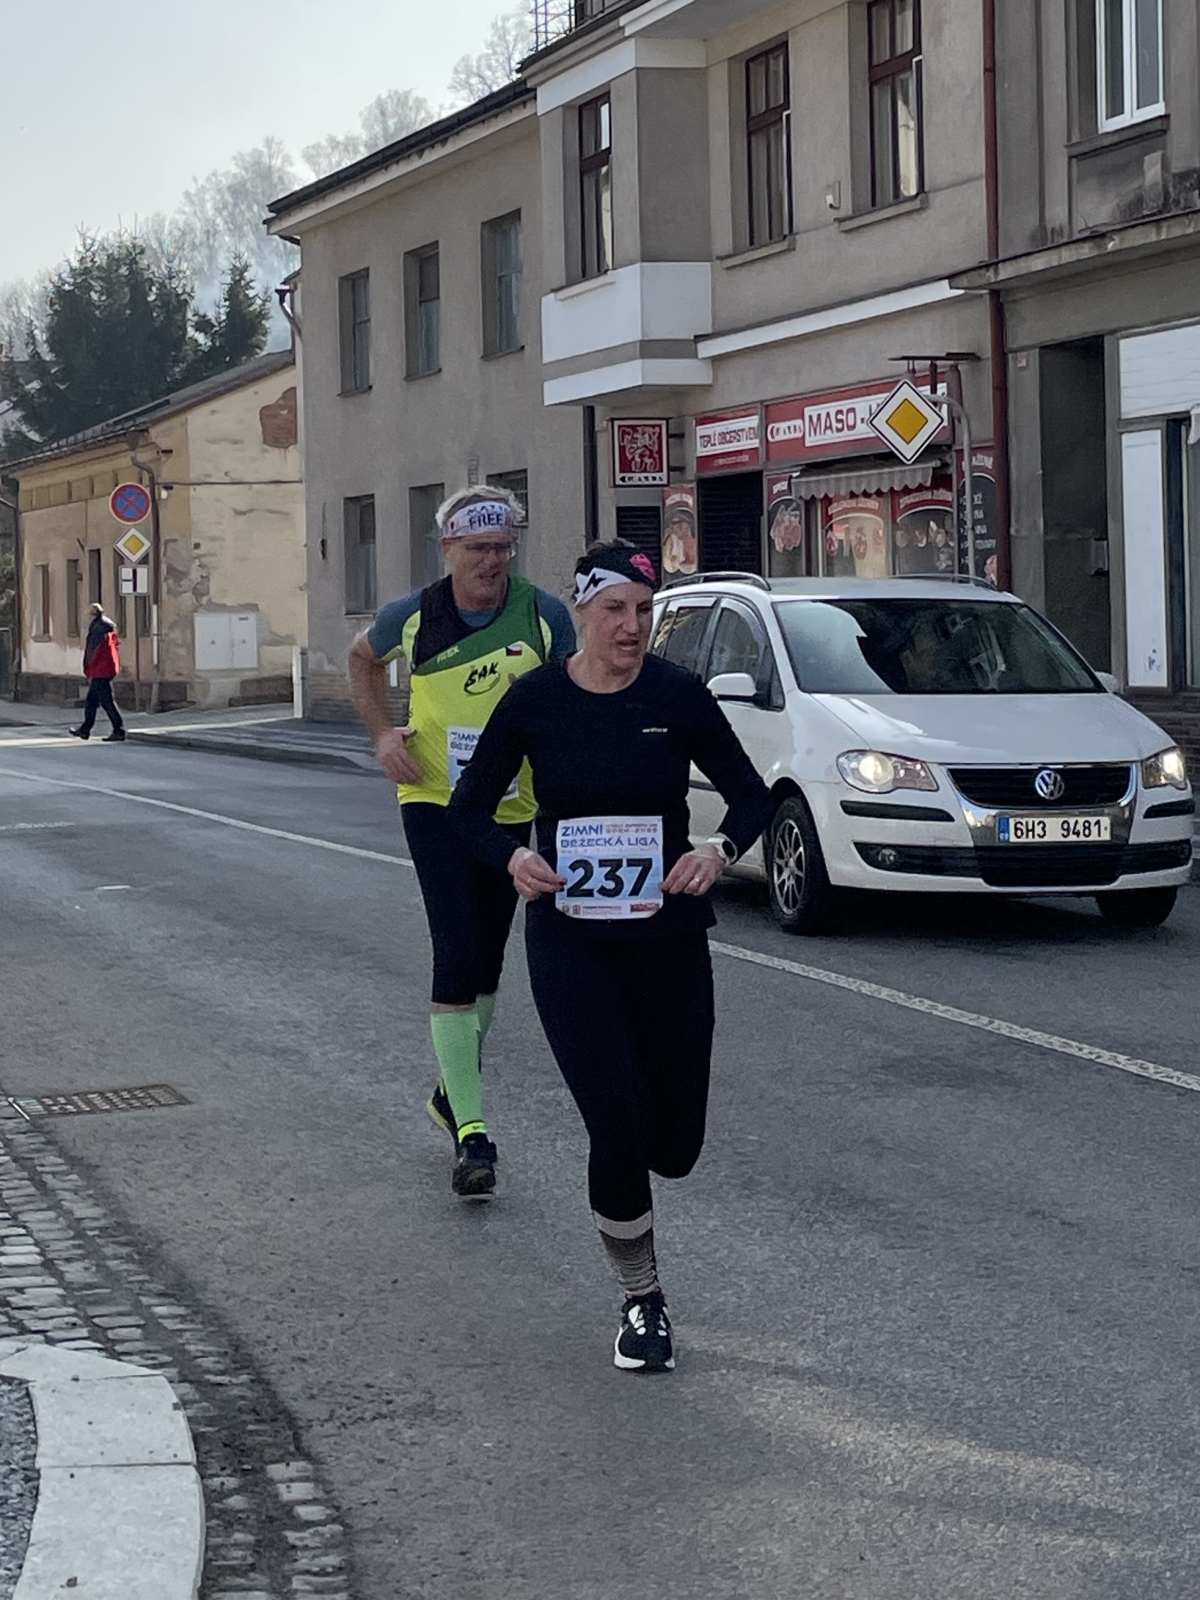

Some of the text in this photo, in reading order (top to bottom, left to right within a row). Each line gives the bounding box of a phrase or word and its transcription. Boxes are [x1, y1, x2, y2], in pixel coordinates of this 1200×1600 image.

[808, 406, 857, 438] MASO
[561, 823, 603, 837] ZIMNÍ
[1014, 819, 1047, 840] 6H3
[1060, 818, 1102, 840] 9481
[627, 836, 660, 847] LIGA
[566, 857, 653, 898] 237
